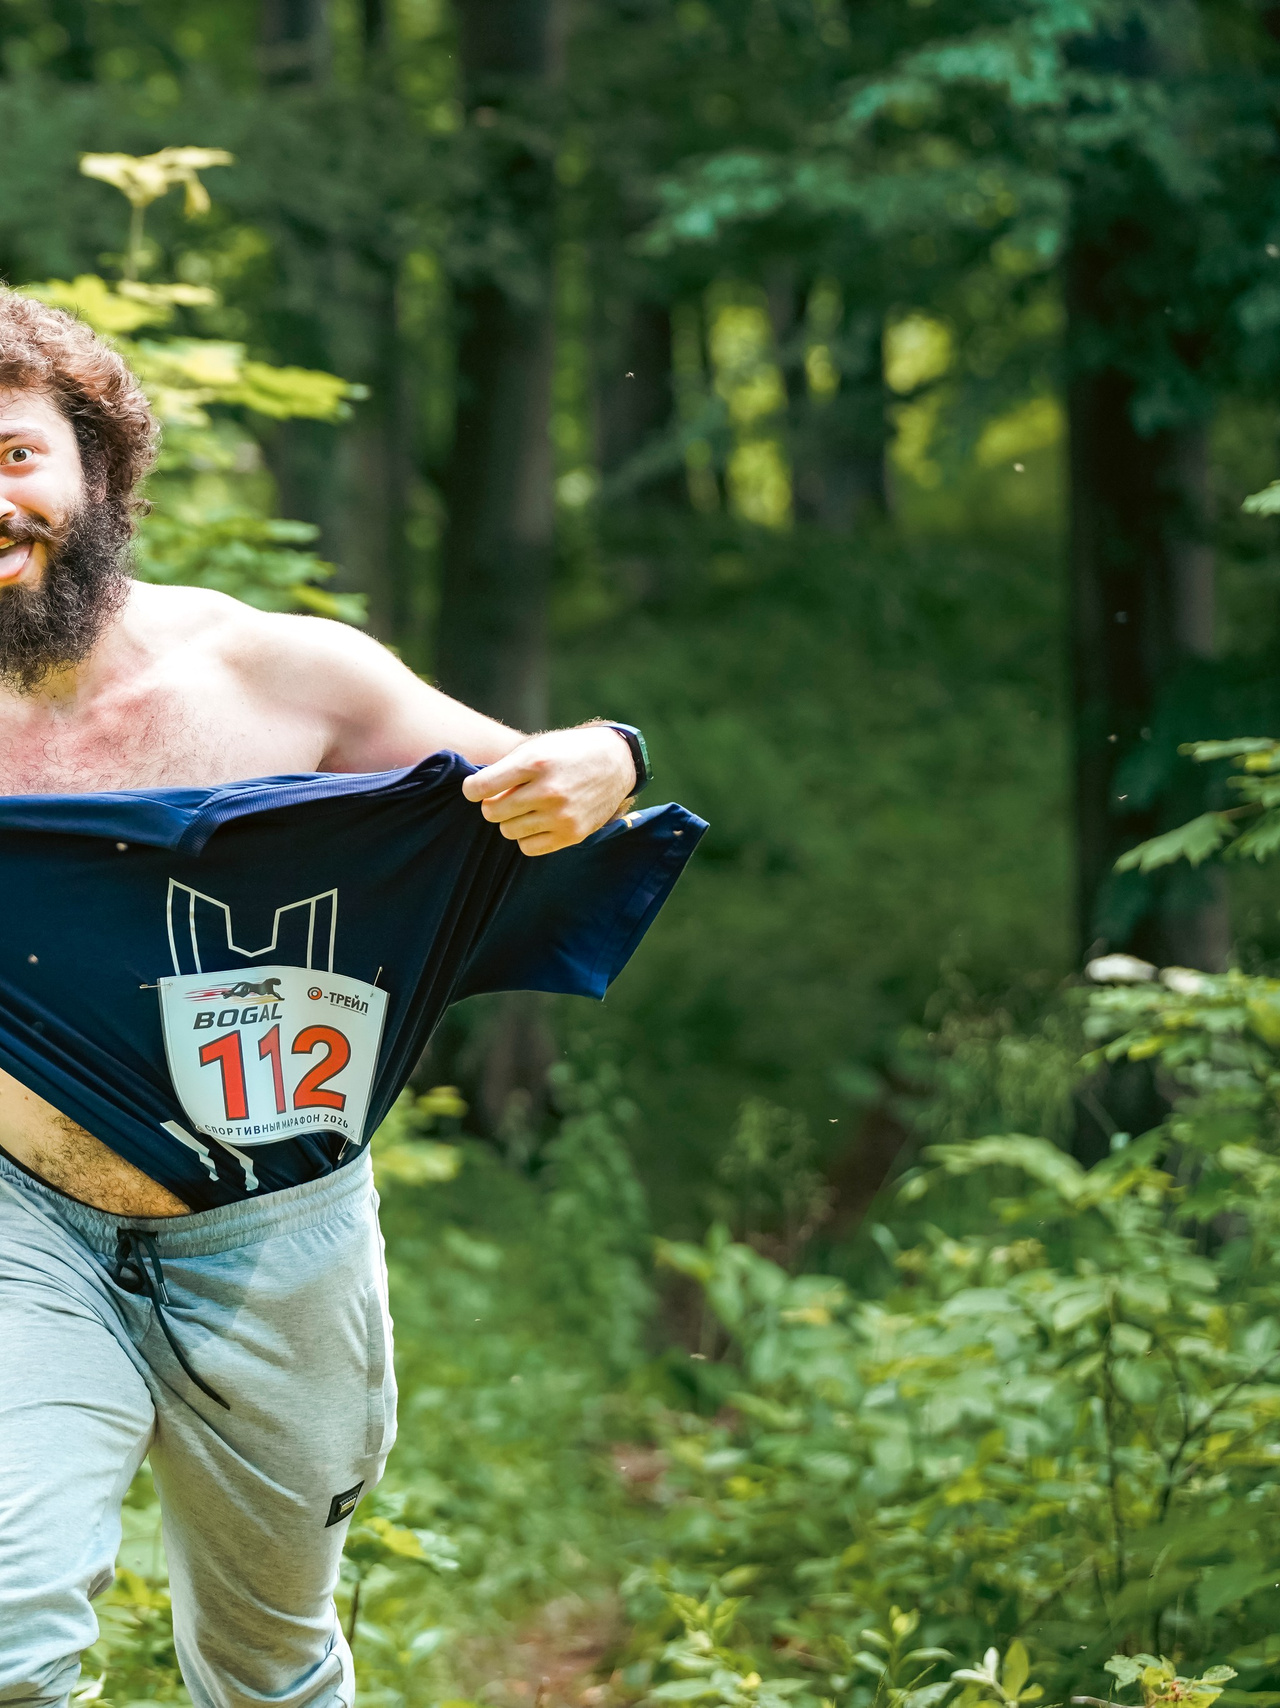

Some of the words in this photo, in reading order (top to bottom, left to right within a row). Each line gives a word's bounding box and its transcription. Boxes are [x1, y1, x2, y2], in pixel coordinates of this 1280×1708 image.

[193, 1003, 283, 1030] BOGAL
[199, 1023, 351, 1121] 112
[281, 1113, 321, 1129] МАРАФОН
